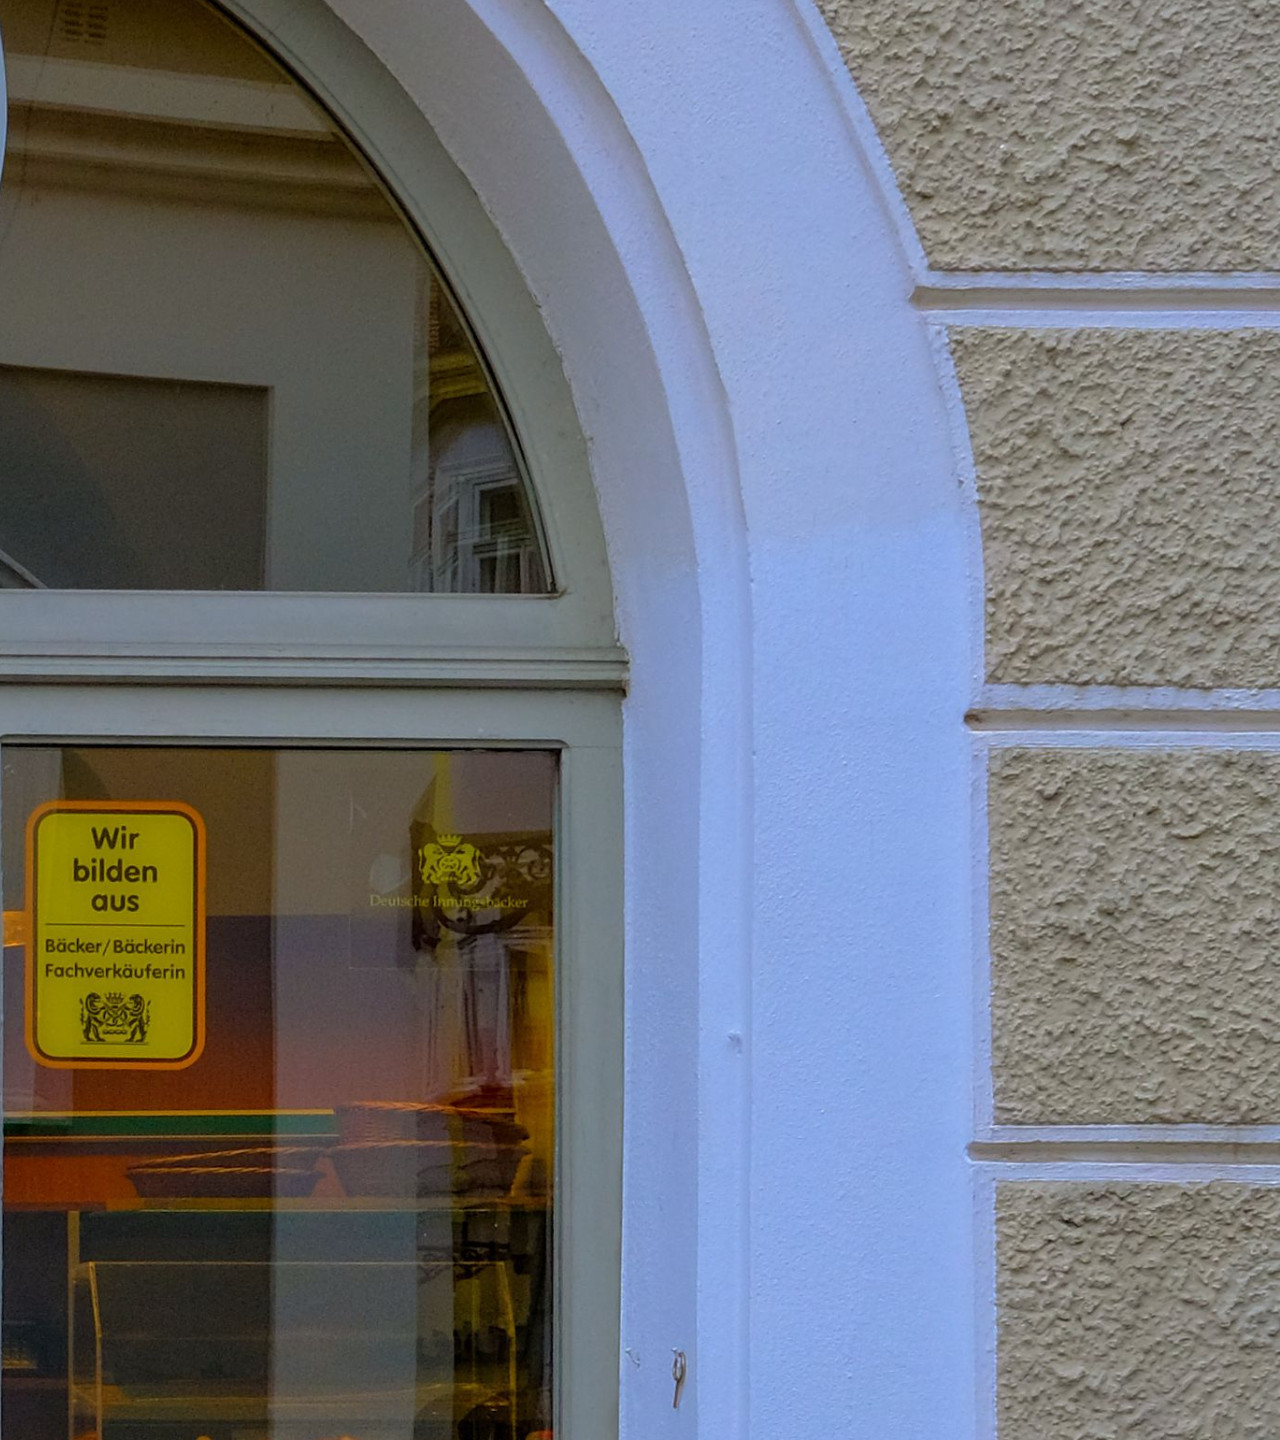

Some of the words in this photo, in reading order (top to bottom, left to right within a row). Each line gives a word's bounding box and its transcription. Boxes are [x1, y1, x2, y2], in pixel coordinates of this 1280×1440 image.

[91, 825, 140, 850] Wir
[73, 858, 158, 883] bilden
[91, 893, 140, 912] aus
[369, 894, 430, 908] Deutsche
[44, 962, 186, 980] Fachverkäuferin
